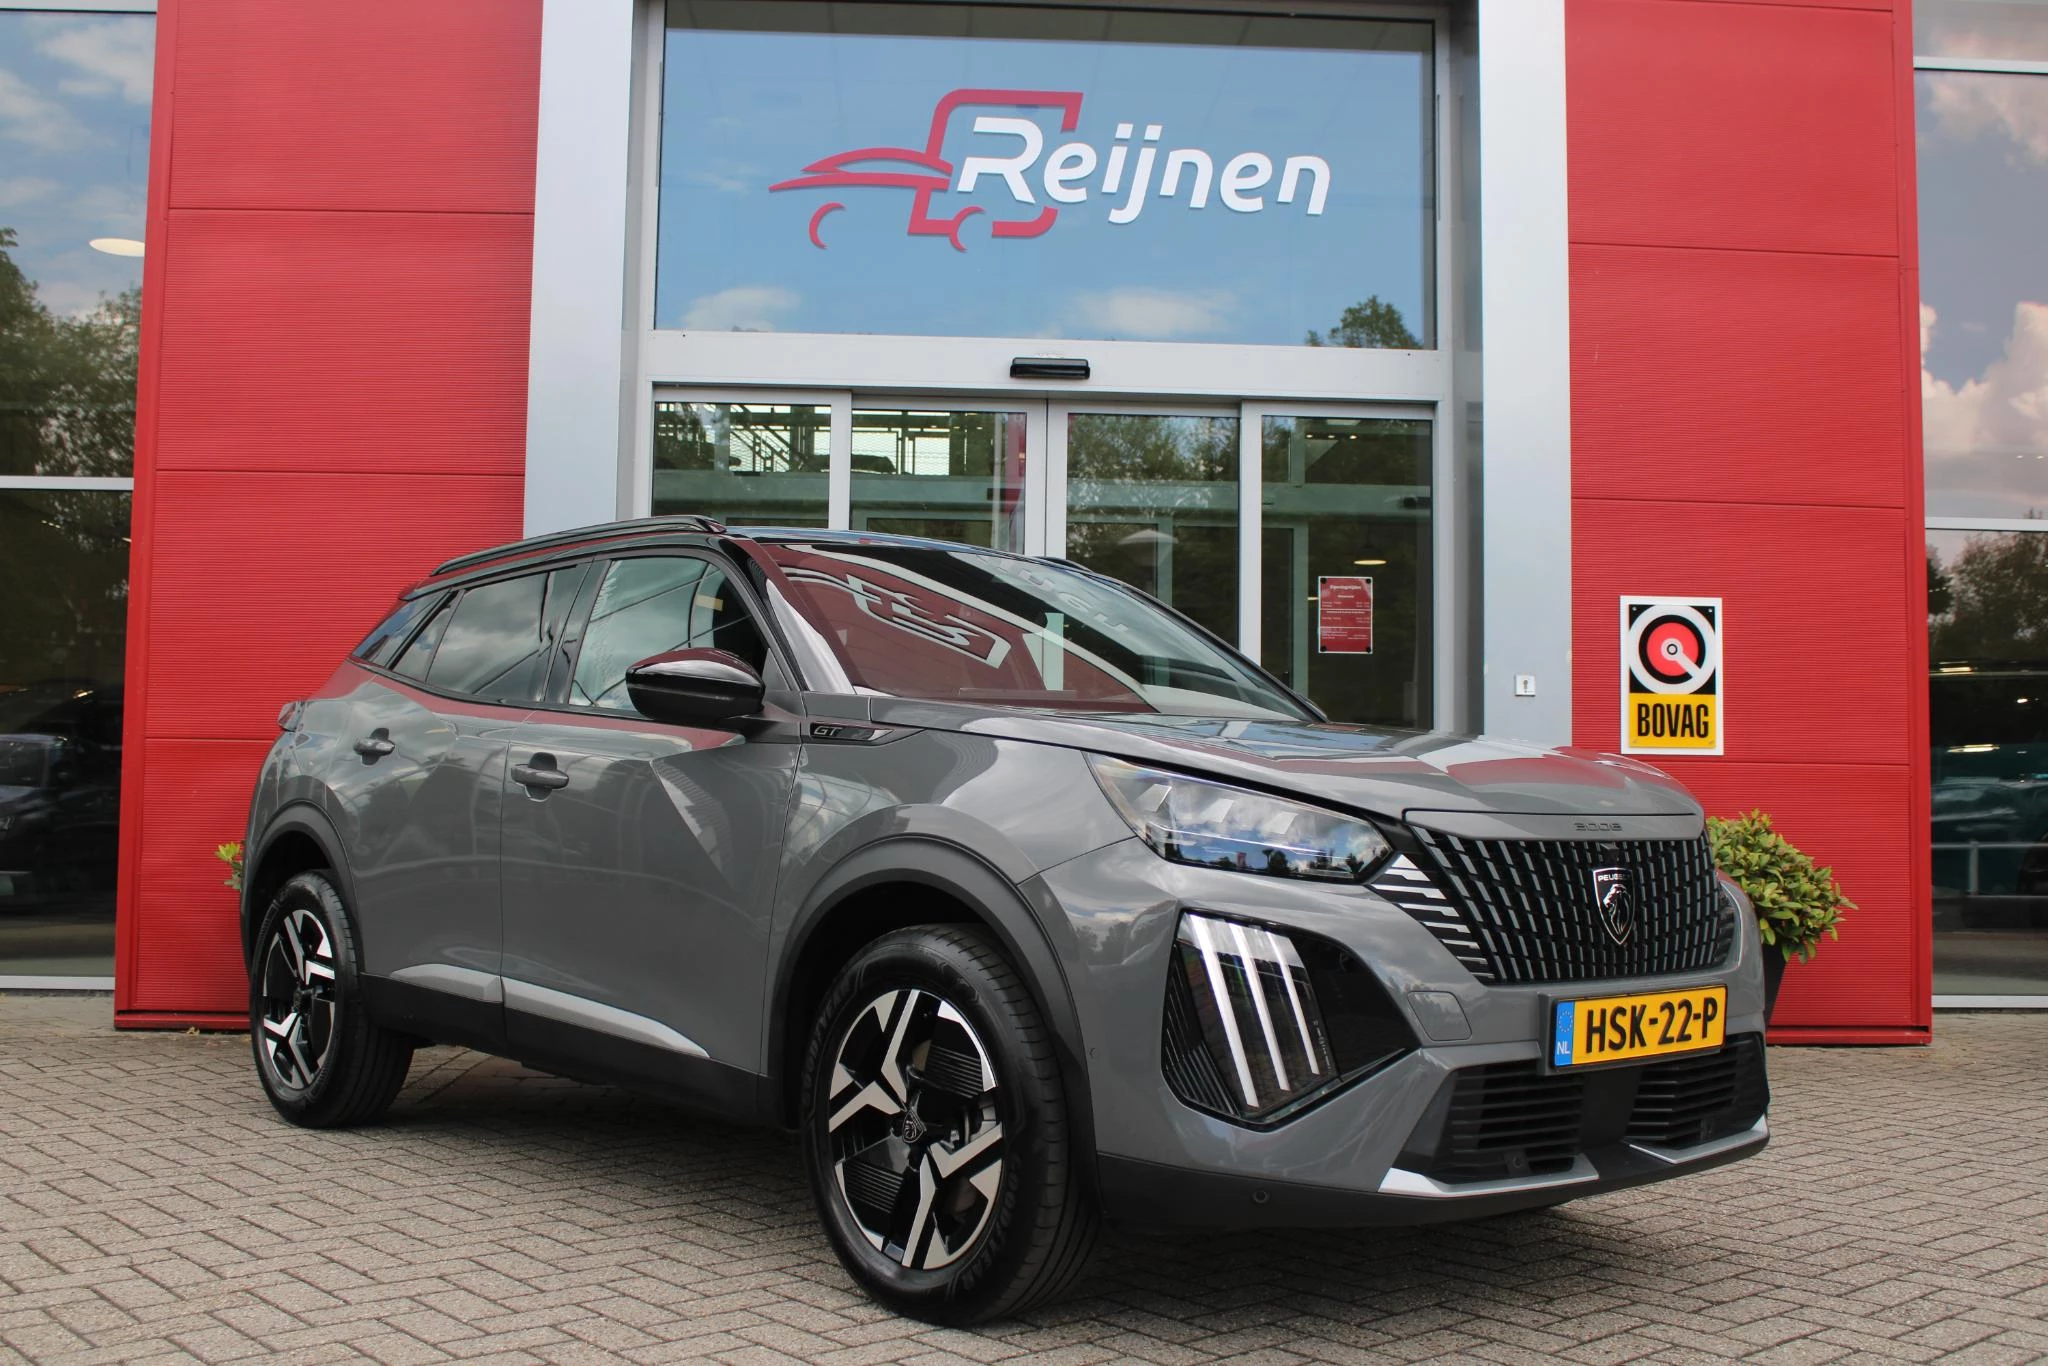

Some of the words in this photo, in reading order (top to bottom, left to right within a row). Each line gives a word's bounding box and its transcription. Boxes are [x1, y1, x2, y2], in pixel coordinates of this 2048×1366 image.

[957, 116, 1331, 224] Reijnen
[814, 725, 843, 736] GT
[1637, 703, 1709, 738] BOVAG
[1556, 1040, 1571, 1055] NL
[1586, 996, 1718, 1054] HSK-22-P
